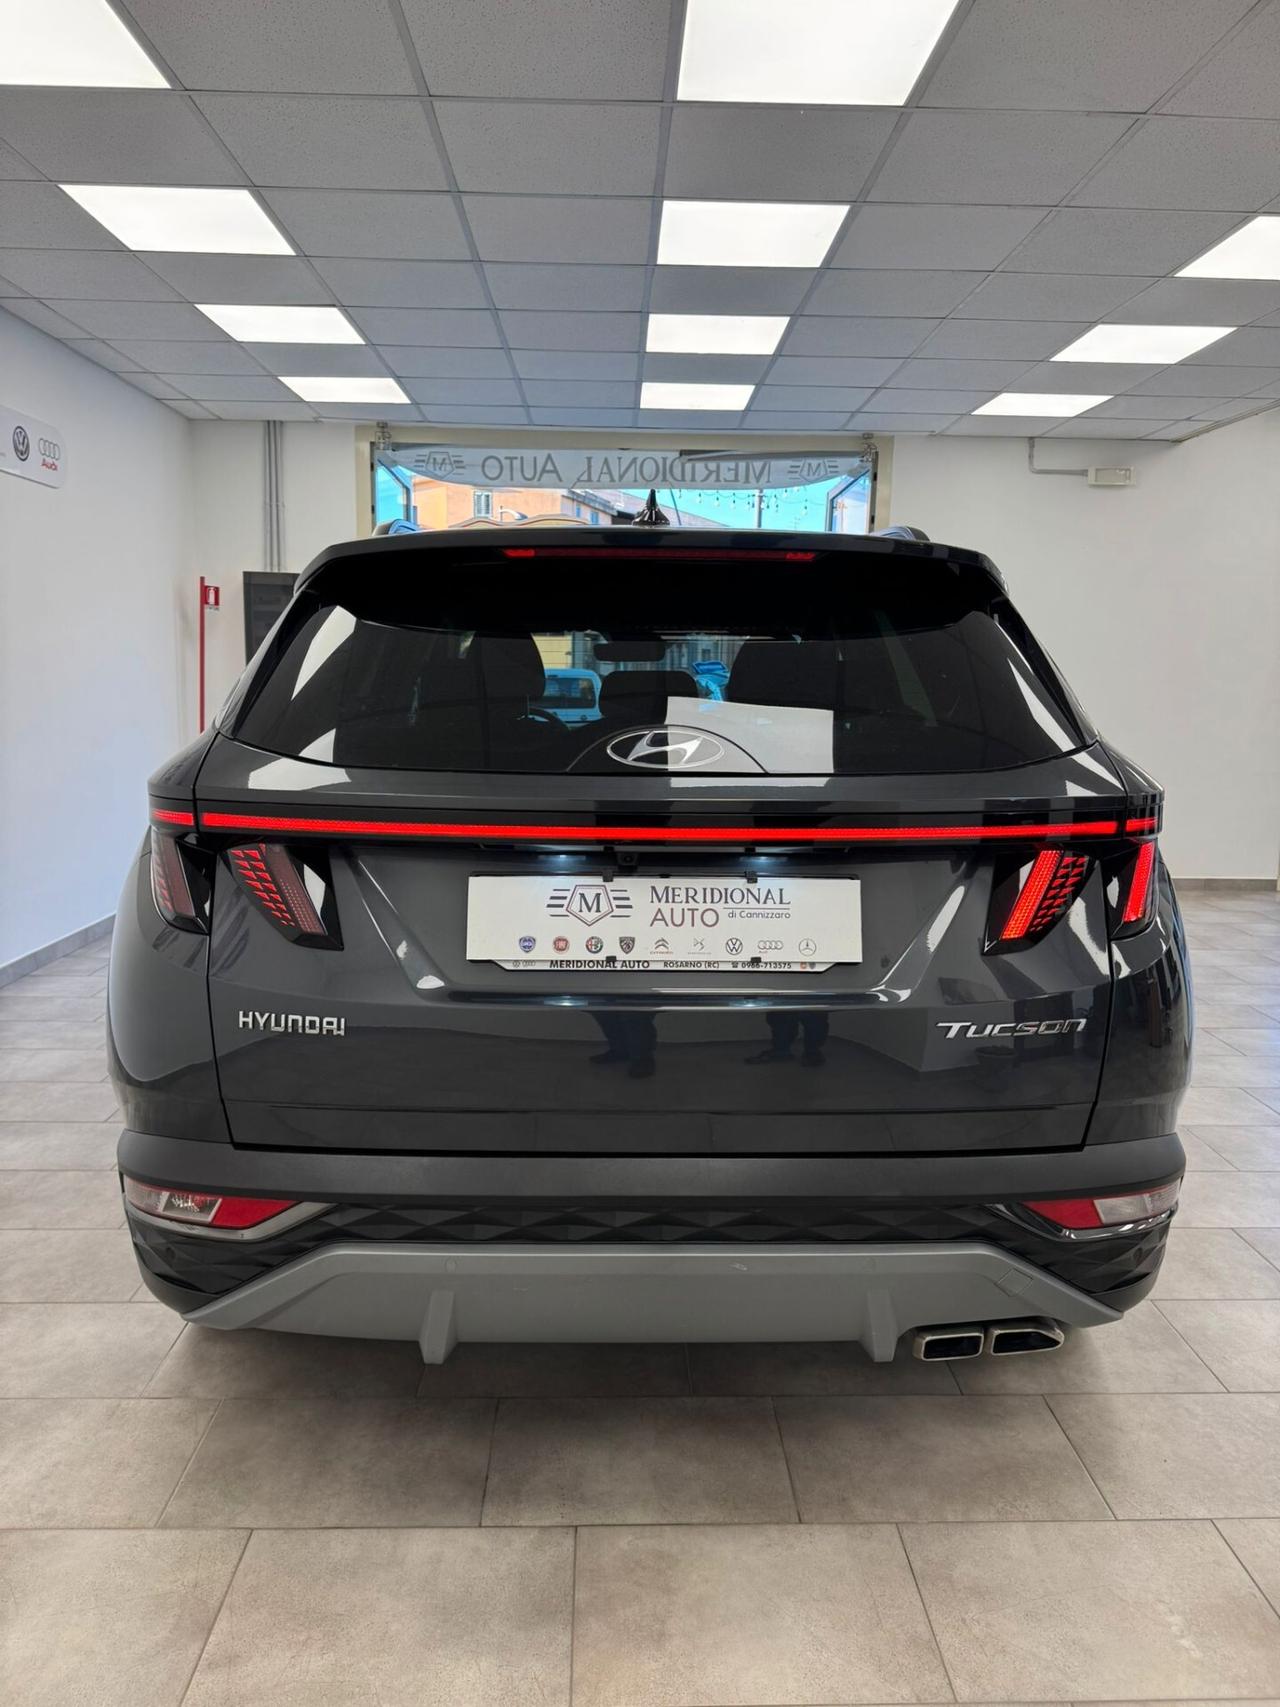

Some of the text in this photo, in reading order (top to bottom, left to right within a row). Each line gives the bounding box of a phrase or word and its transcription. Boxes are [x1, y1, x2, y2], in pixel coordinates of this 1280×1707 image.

[578, 892, 602, 913] M
[650, 885, 791, 905] MERIDIONAL
[649, 907, 720, 928] AUTO
[727, 909, 791, 919] di Cannizzaro
[550, 959, 617, 969] MERIDIONAL
[620, 959, 650, 969] AUTO
[663, 961, 702, 969] ROSARNO
[704, 961, 720, 970] (RC)
[238, 1010, 346, 1037] HYUNDAI
